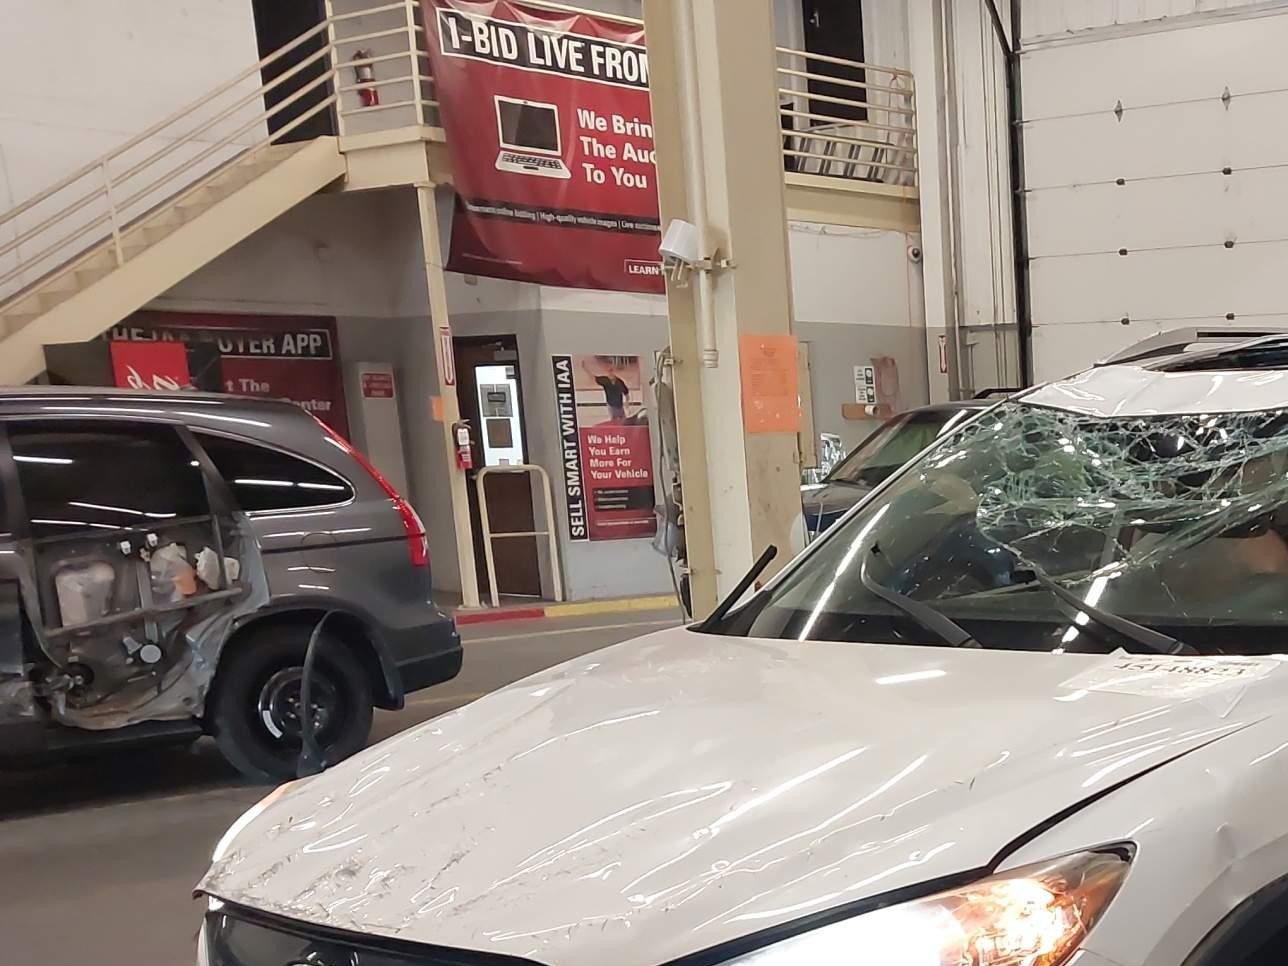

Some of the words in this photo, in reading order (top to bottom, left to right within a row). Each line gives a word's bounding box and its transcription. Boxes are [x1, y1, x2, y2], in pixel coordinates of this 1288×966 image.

[527, 32, 585, 73] LIVE
[577, 108, 607, 132] We
[612, 114, 653, 138] Brin
[579, 136, 616, 159] The
[582, 163, 606, 184] To
[610, 166, 647, 189] You
[628, 264, 659, 275] LEARN
[281, 333, 322, 355] APP
[239, 378, 271, 393] The
[556, 360, 571, 388] IAA
[558, 393, 576, 436] WITH
[587, 435, 602, 444] We
[604, 434, 626, 446] Help
[588, 446, 607, 456] You
[609, 446, 631, 456] Earn
[563, 439, 581, 496] SMART
[589, 459, 614, 468] More
[616, 458, 632, 467] For
[590, 470, 613, 480] Your
[614, 468, 648, 479] Vehicle
[569, 500, 585, 536] SELL
